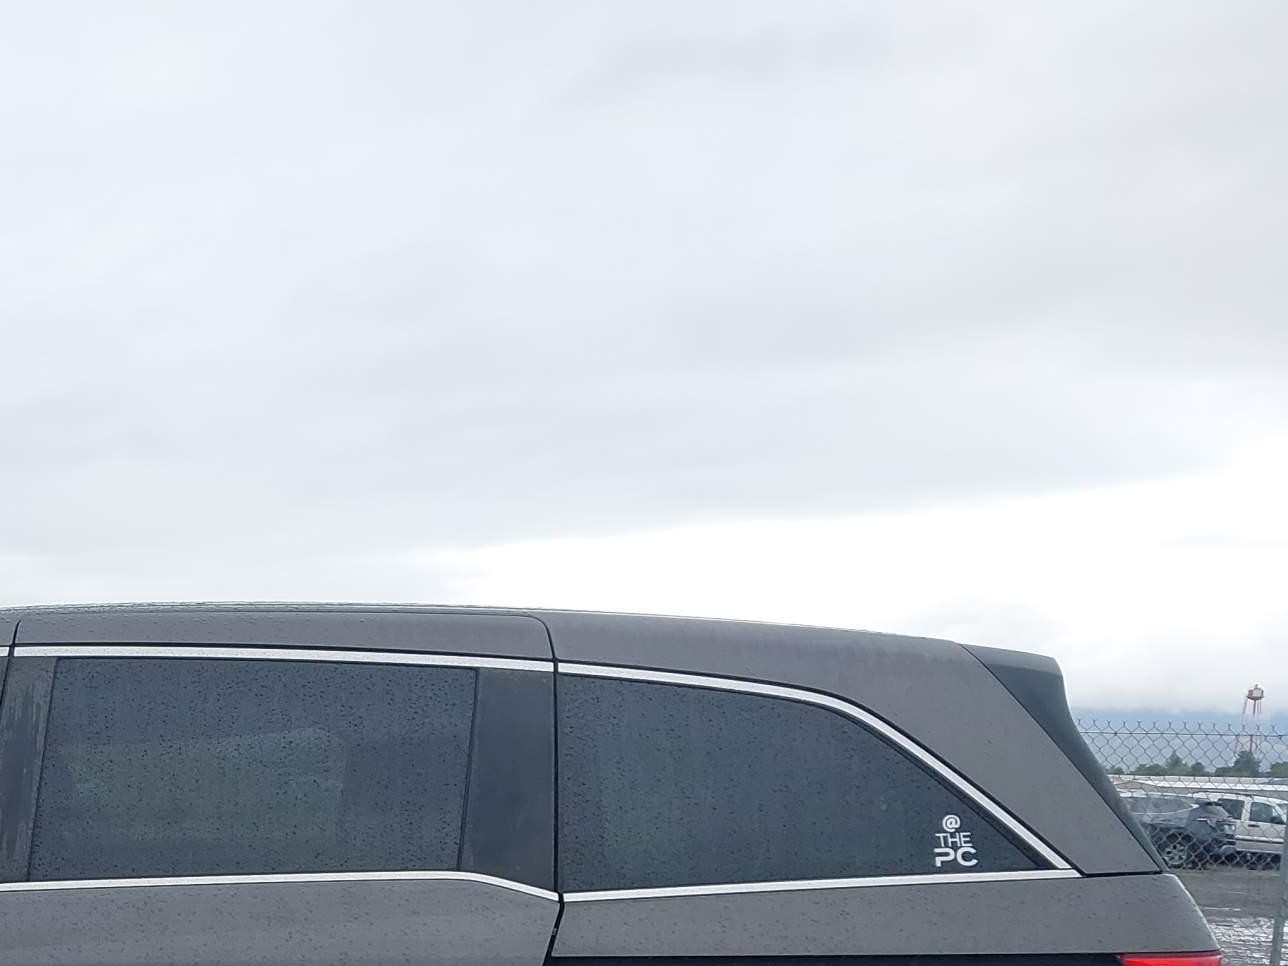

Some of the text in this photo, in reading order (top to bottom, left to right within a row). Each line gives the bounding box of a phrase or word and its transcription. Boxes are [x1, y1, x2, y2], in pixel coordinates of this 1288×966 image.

[942, 814, 961, 832] @
[934, 832, 973, 847] THE
[933, 847, 978, 867] PC
